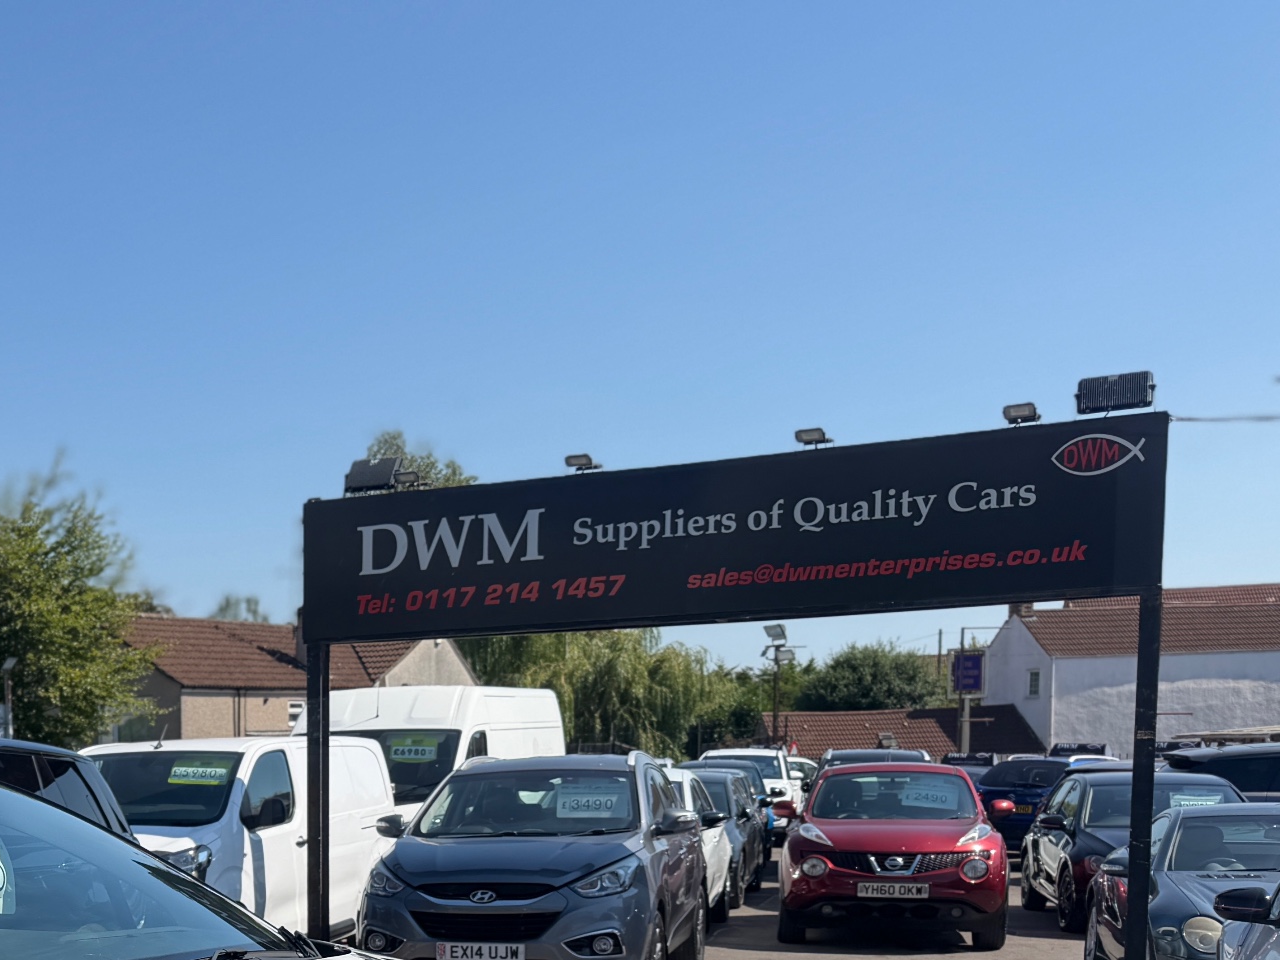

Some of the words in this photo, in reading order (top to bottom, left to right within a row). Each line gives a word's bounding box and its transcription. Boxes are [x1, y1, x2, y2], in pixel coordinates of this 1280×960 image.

[1063, 439, 1119, 470] DWM
[573, 508, 737, 551] Suppliers
[747, 499, 784, 531] of
[793, 488, 938, 532] Quality
[948, 481, 1037, 513] Cars
[357, 508, 545, 576] DWM
[687, 540, 1088, 589] sales@dwmenterprises.co.uk
[356, 593, 396, 615] Tel:
[405, 587, 476, 611] 0117
[484, 581, 540, 606] 214
[552, 575, 626, 600] 1457
[863, 884, 896, 896] YH60
[450, 945, 484, 959] EX14
[488, 945, 519, 960] UJW
